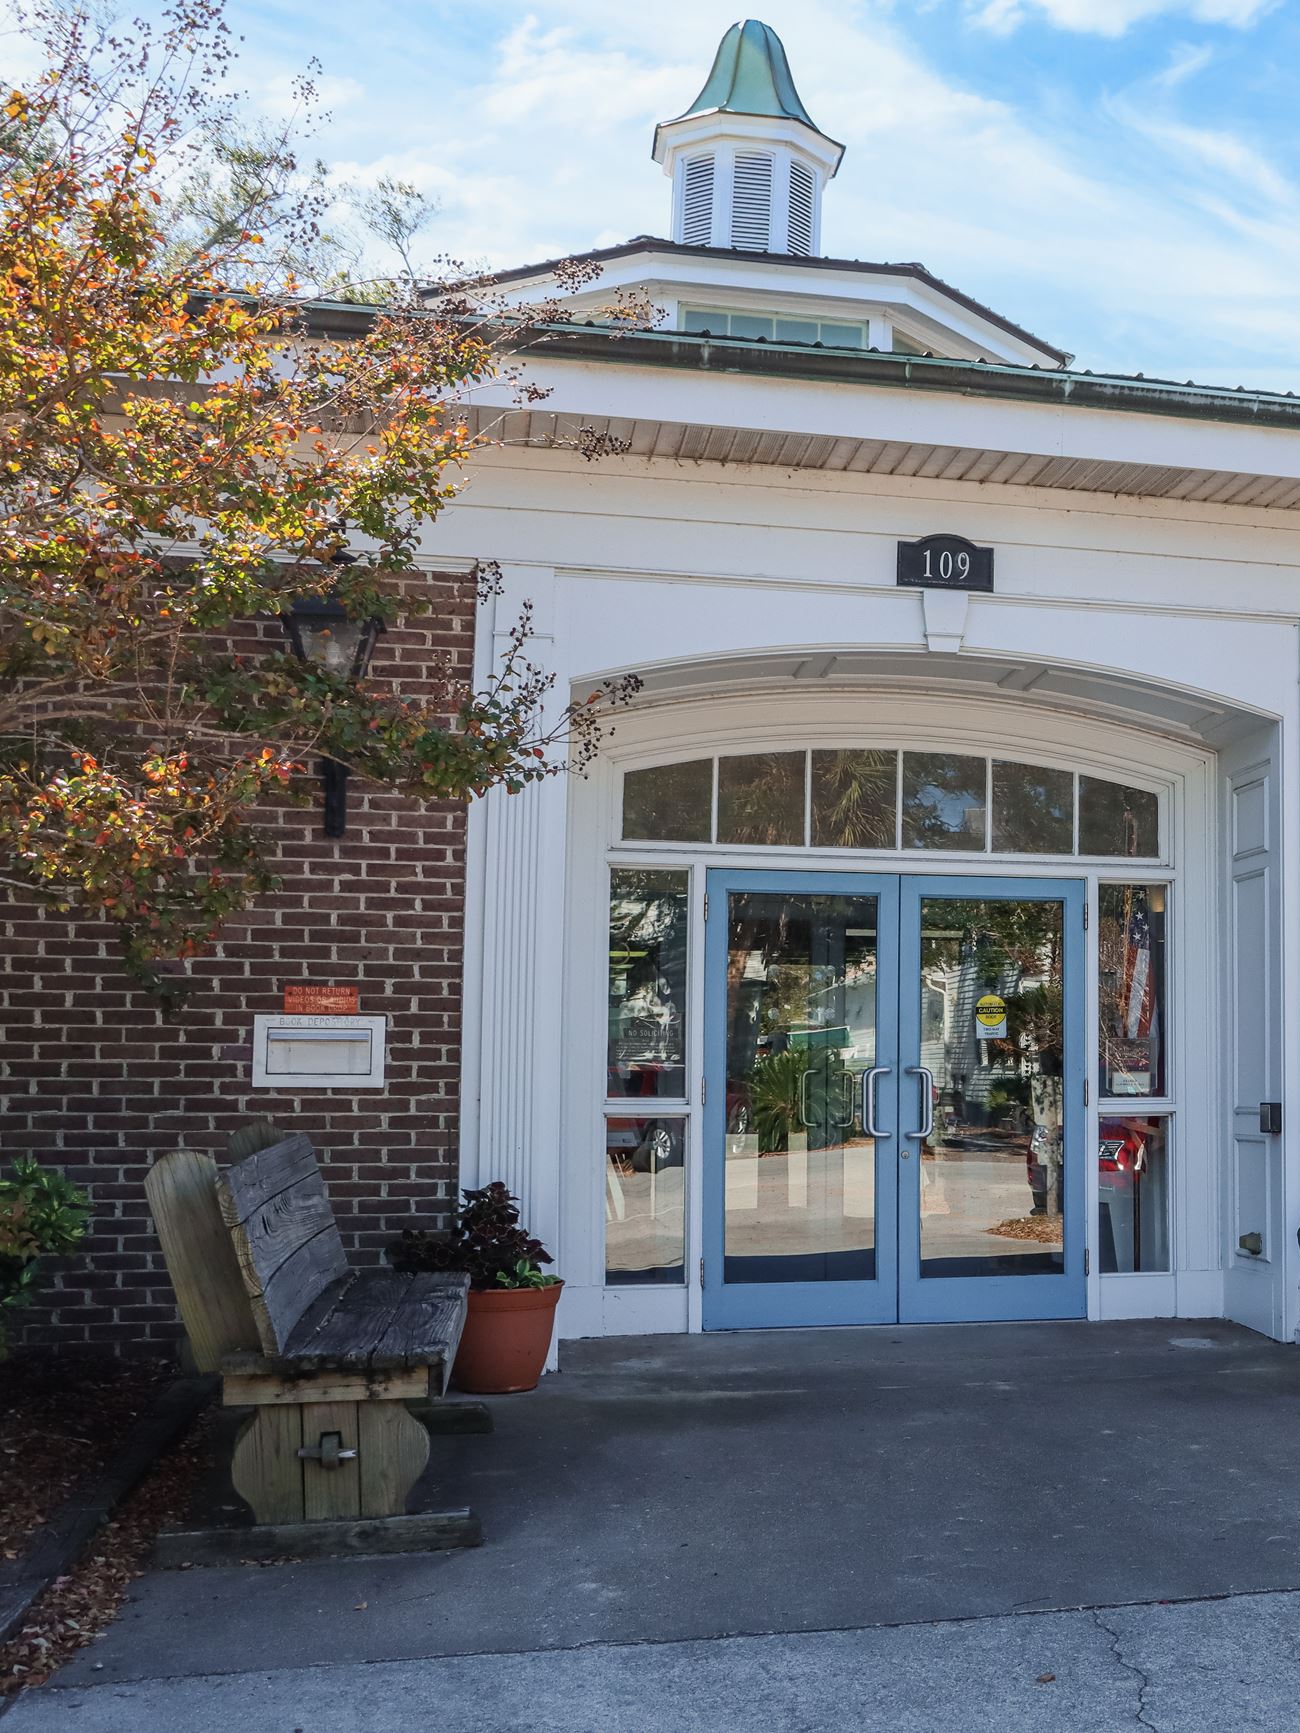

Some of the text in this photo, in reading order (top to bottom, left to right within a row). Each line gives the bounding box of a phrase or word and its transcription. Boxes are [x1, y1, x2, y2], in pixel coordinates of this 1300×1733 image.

[923, 549, 970, 580] 109
[293, 987, 351, 995] DO NOT RETURN
[287, 995, 315, 1003] VIDEOS
[279, 1017, 302, 1026] BOOK
